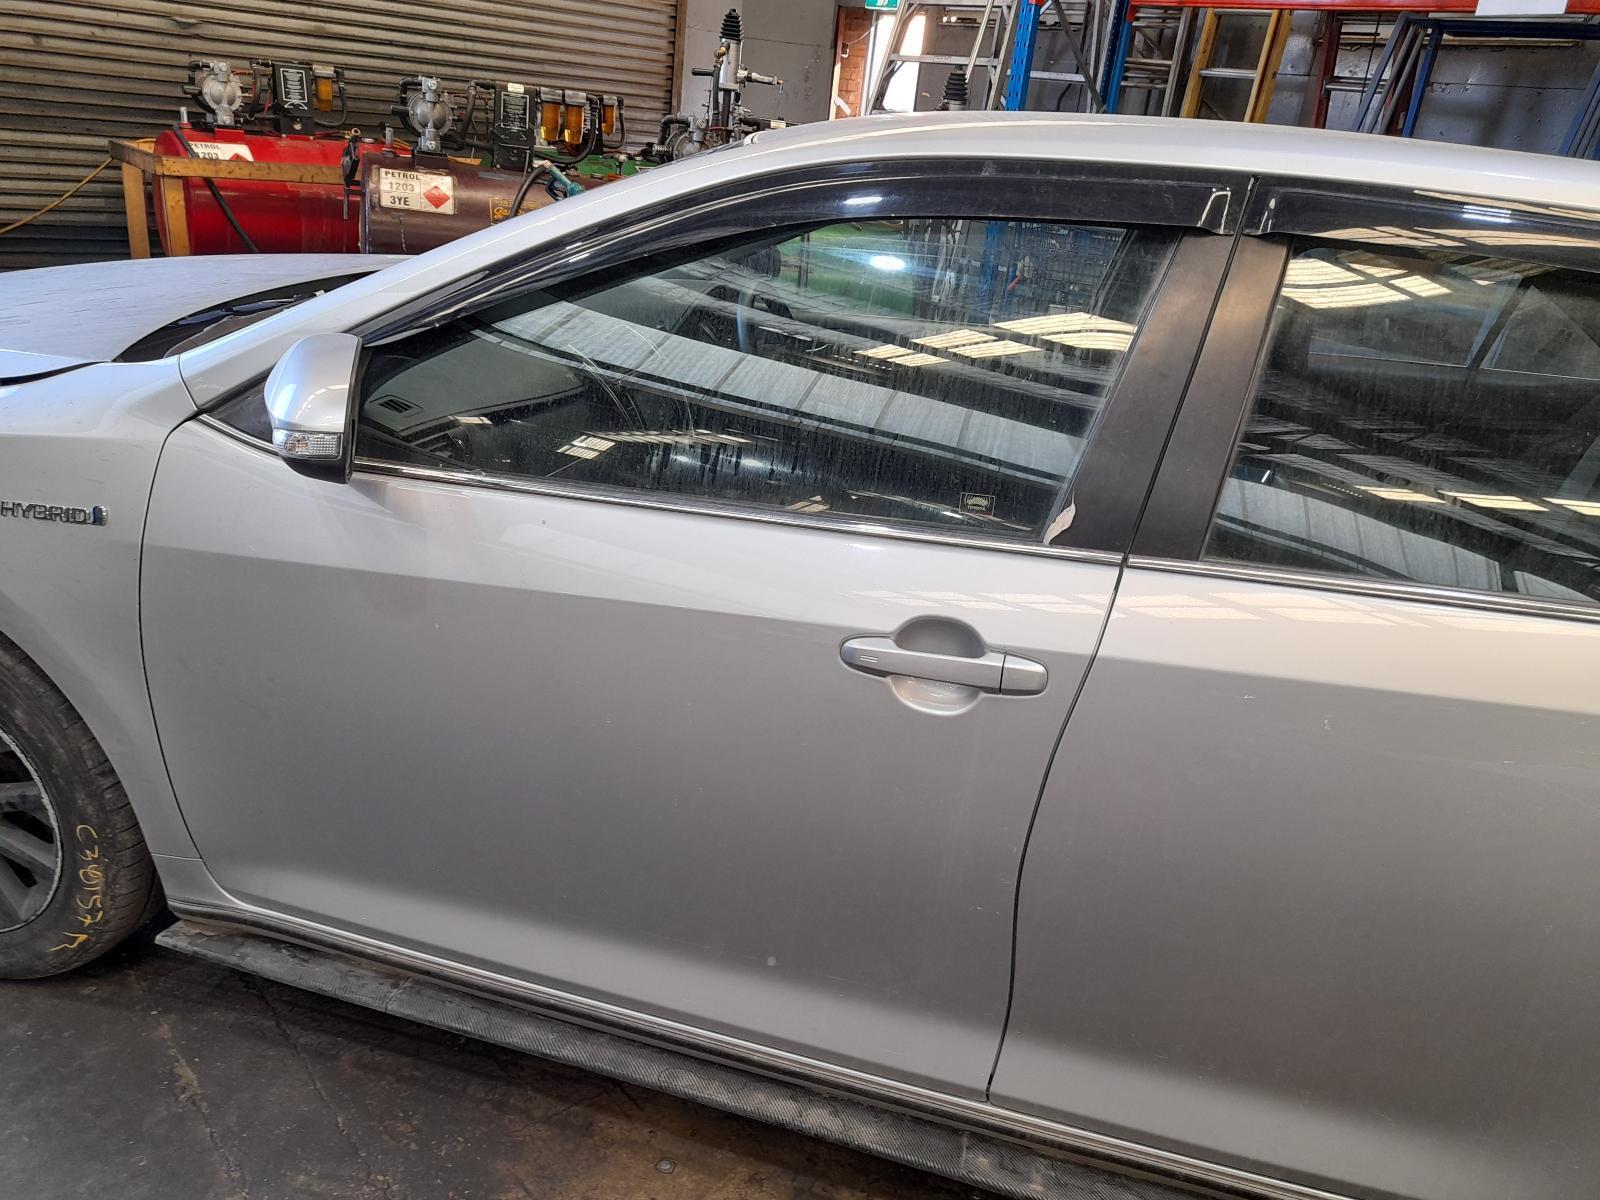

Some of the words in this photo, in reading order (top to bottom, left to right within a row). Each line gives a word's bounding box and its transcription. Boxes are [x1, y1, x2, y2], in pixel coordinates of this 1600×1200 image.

[385, 171, 420, 180] PETROL
[389, 181, 415, 192] 1203
[390, 195, 409, 206] 3YE
[0, 501, 88, 524] HYBRID
